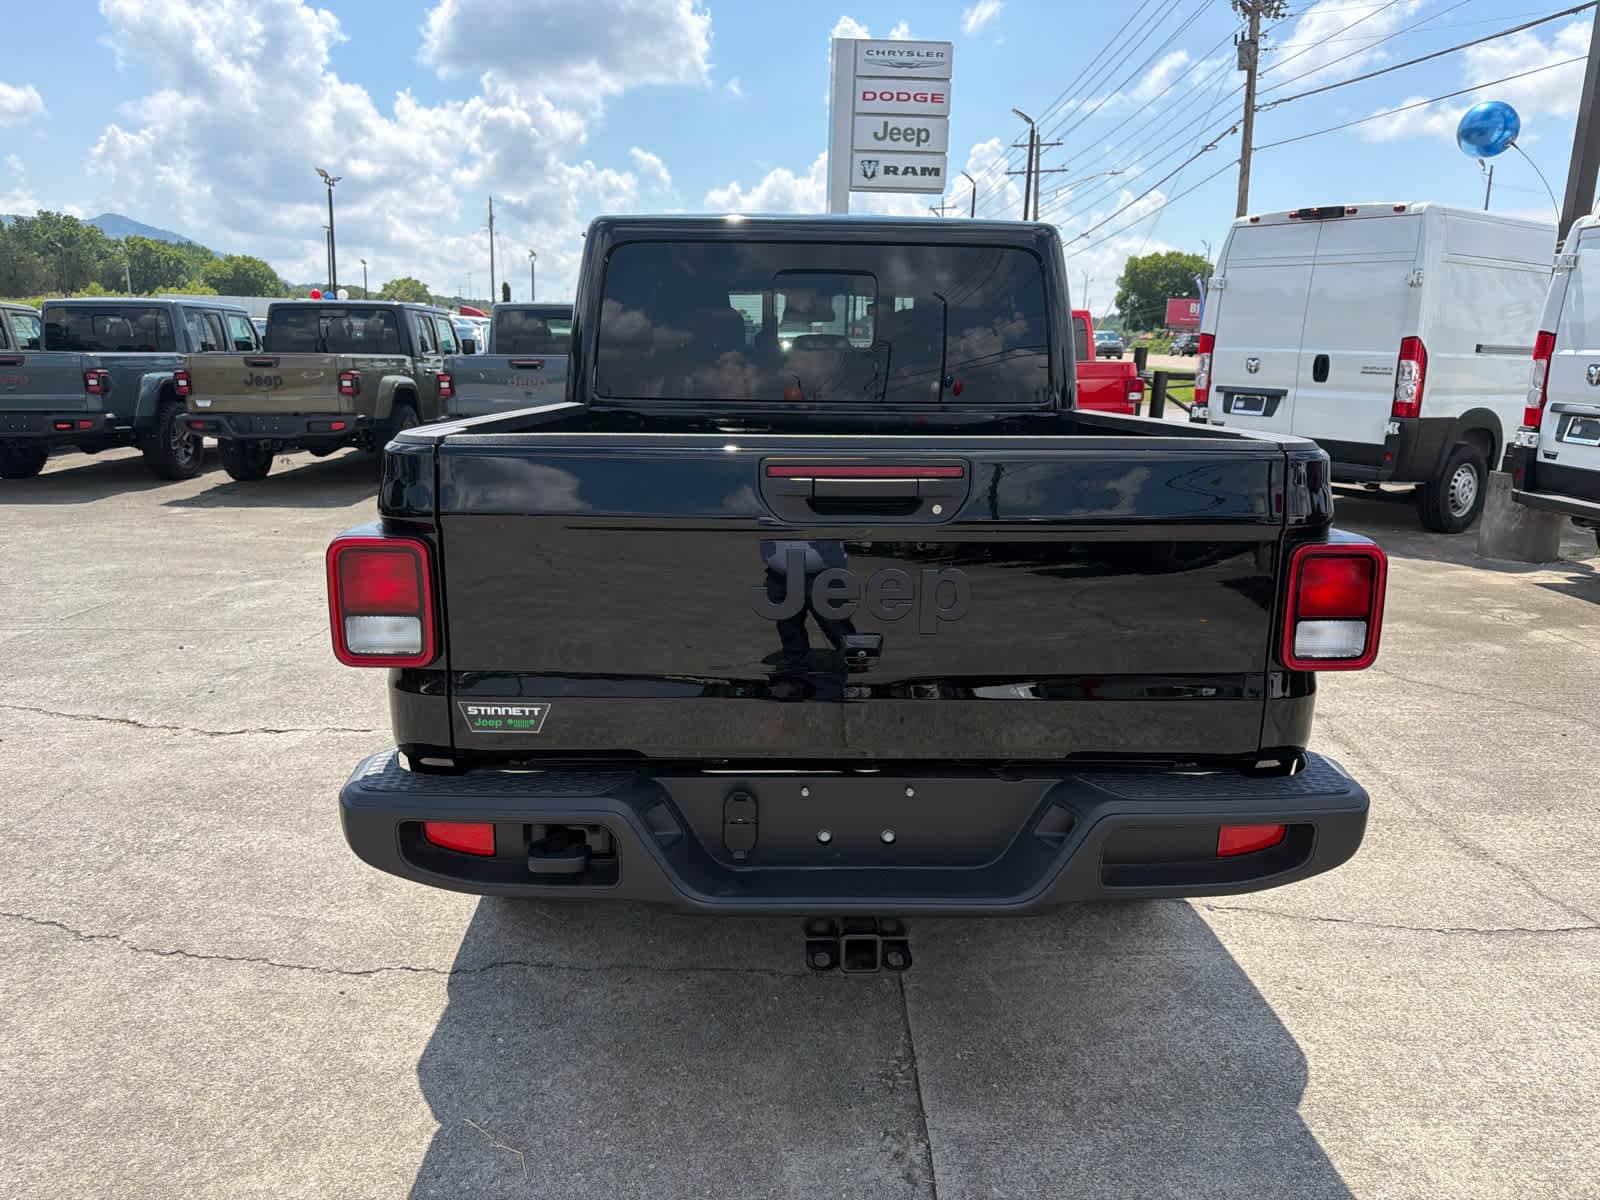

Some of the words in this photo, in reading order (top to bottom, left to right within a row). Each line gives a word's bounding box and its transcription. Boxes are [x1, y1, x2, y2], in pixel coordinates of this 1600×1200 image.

[865, 49, 945, 58] CHRYSLER
[862, 91, 945, 104] DODGE
[873, 121, 931, 147] Jeep
[883, 165, 941, 177] RAM
[243, 371, 283, 390] Jeep
[751, 548, 972, 635] Jeep
[467, 706, 541, 716] STINNETT
[474, 718, 503, 728] Jeep
